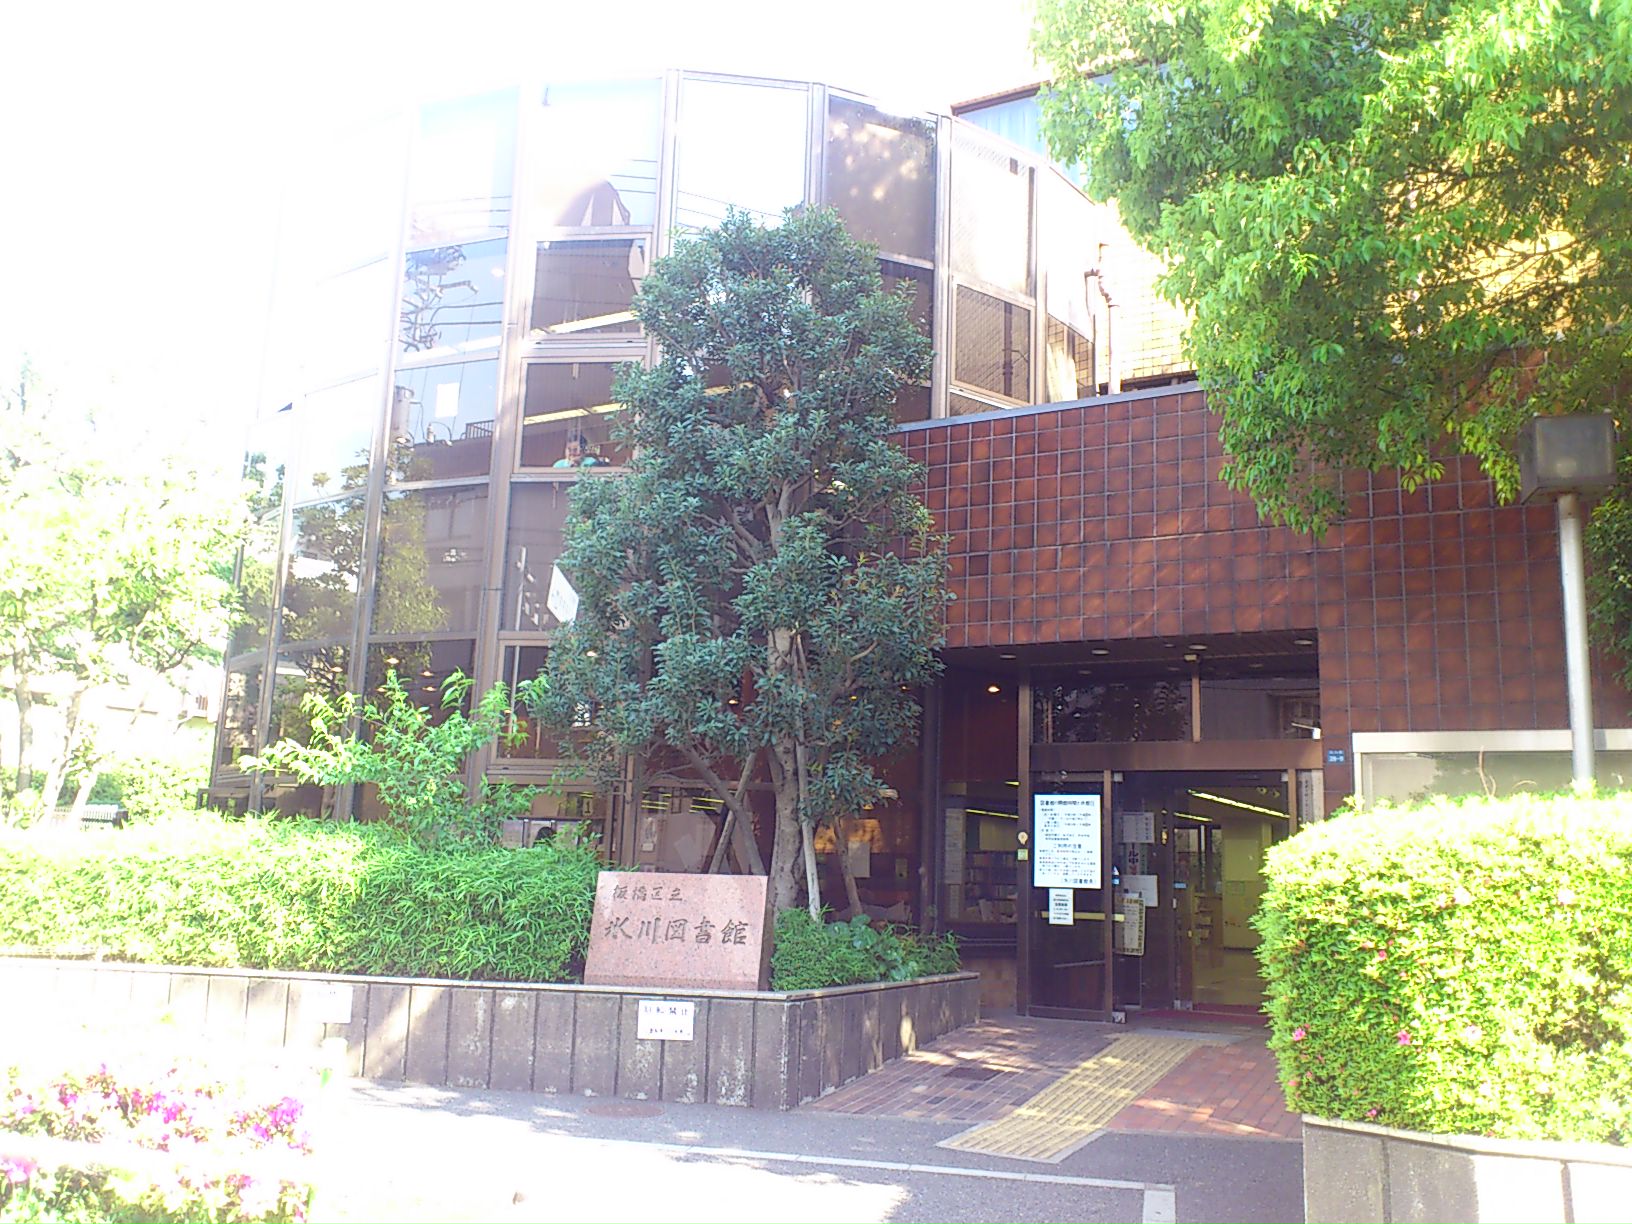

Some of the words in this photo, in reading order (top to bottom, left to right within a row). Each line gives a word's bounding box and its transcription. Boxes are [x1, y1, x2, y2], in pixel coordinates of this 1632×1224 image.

[613, 884, 684, 902] 板橋区立
[604, 916, 749, 945] 氷川図書館
